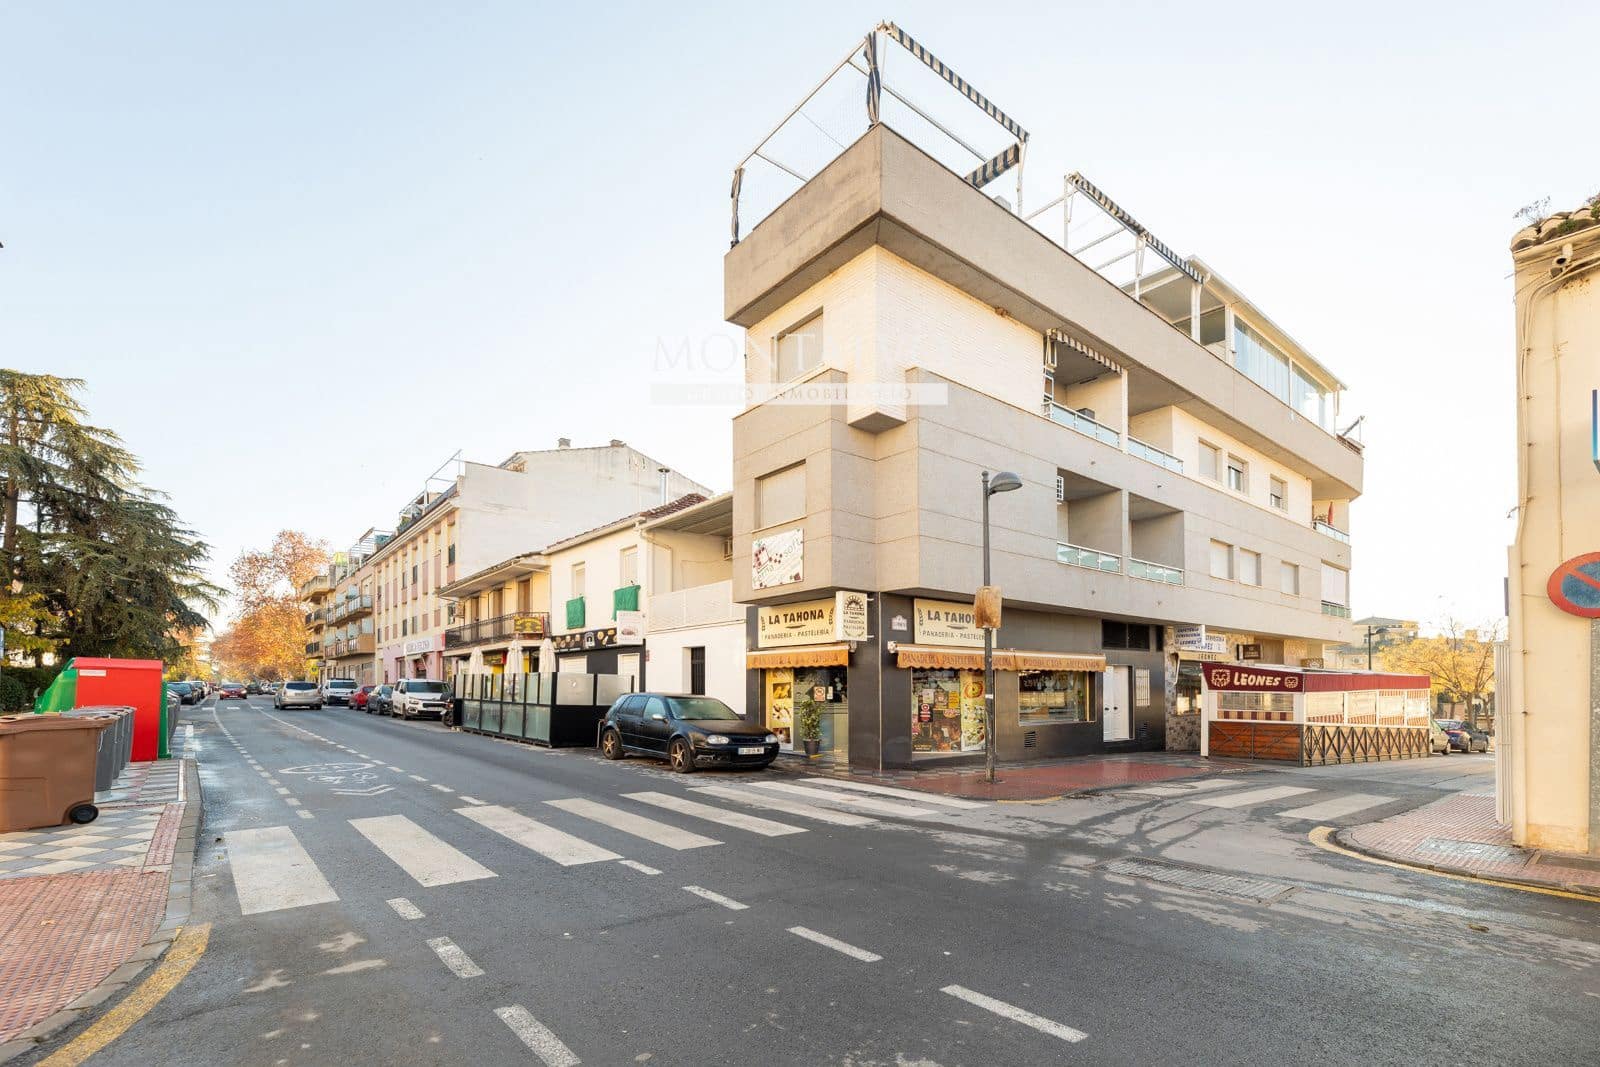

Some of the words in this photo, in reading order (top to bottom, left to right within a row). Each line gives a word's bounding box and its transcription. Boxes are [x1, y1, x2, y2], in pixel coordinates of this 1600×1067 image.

[768, 615, 781, 625] LA
[783, 609, 825, 624] TAHONA
[927, 610, 941, 622] LA
[944, 611, 977, 625] TAHON
[1233, 671, 1281, 687] LEONES
